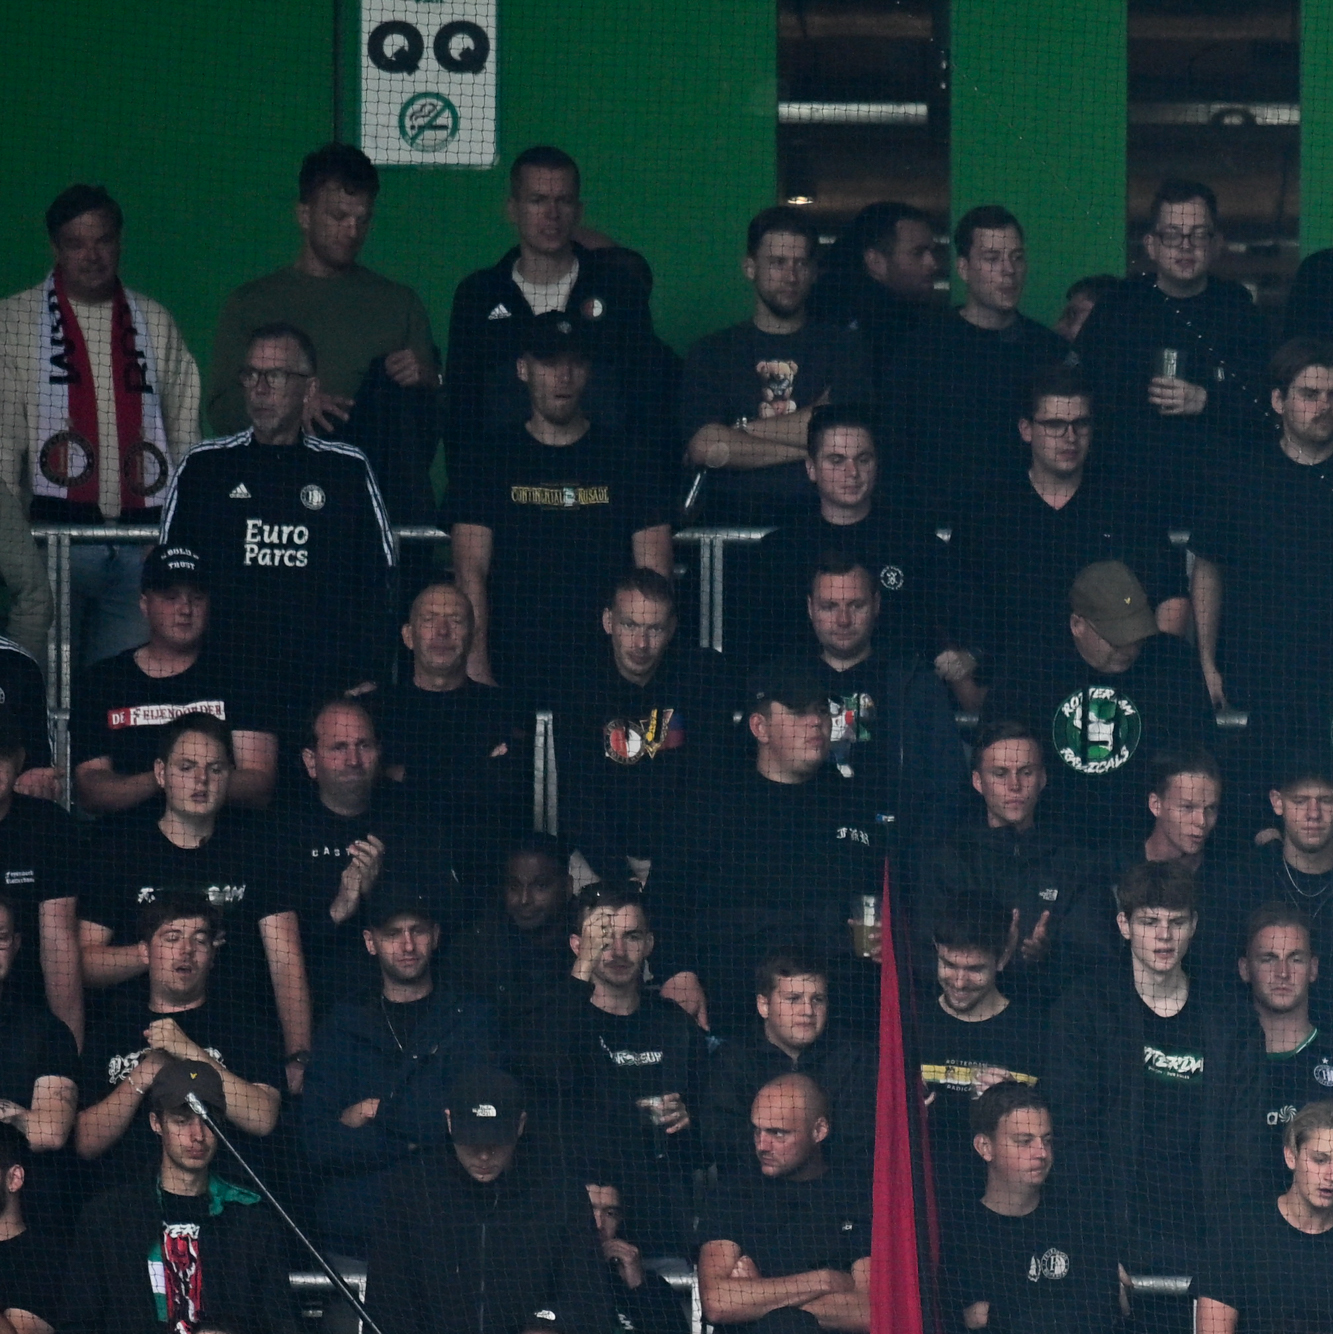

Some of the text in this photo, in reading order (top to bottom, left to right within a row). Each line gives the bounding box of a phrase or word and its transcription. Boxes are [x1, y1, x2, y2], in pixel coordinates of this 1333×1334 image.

[369, 21, 491, 75] QQ
[245, 519, 309, 543] Euro
[244, 544, 308, 567] Parcs
